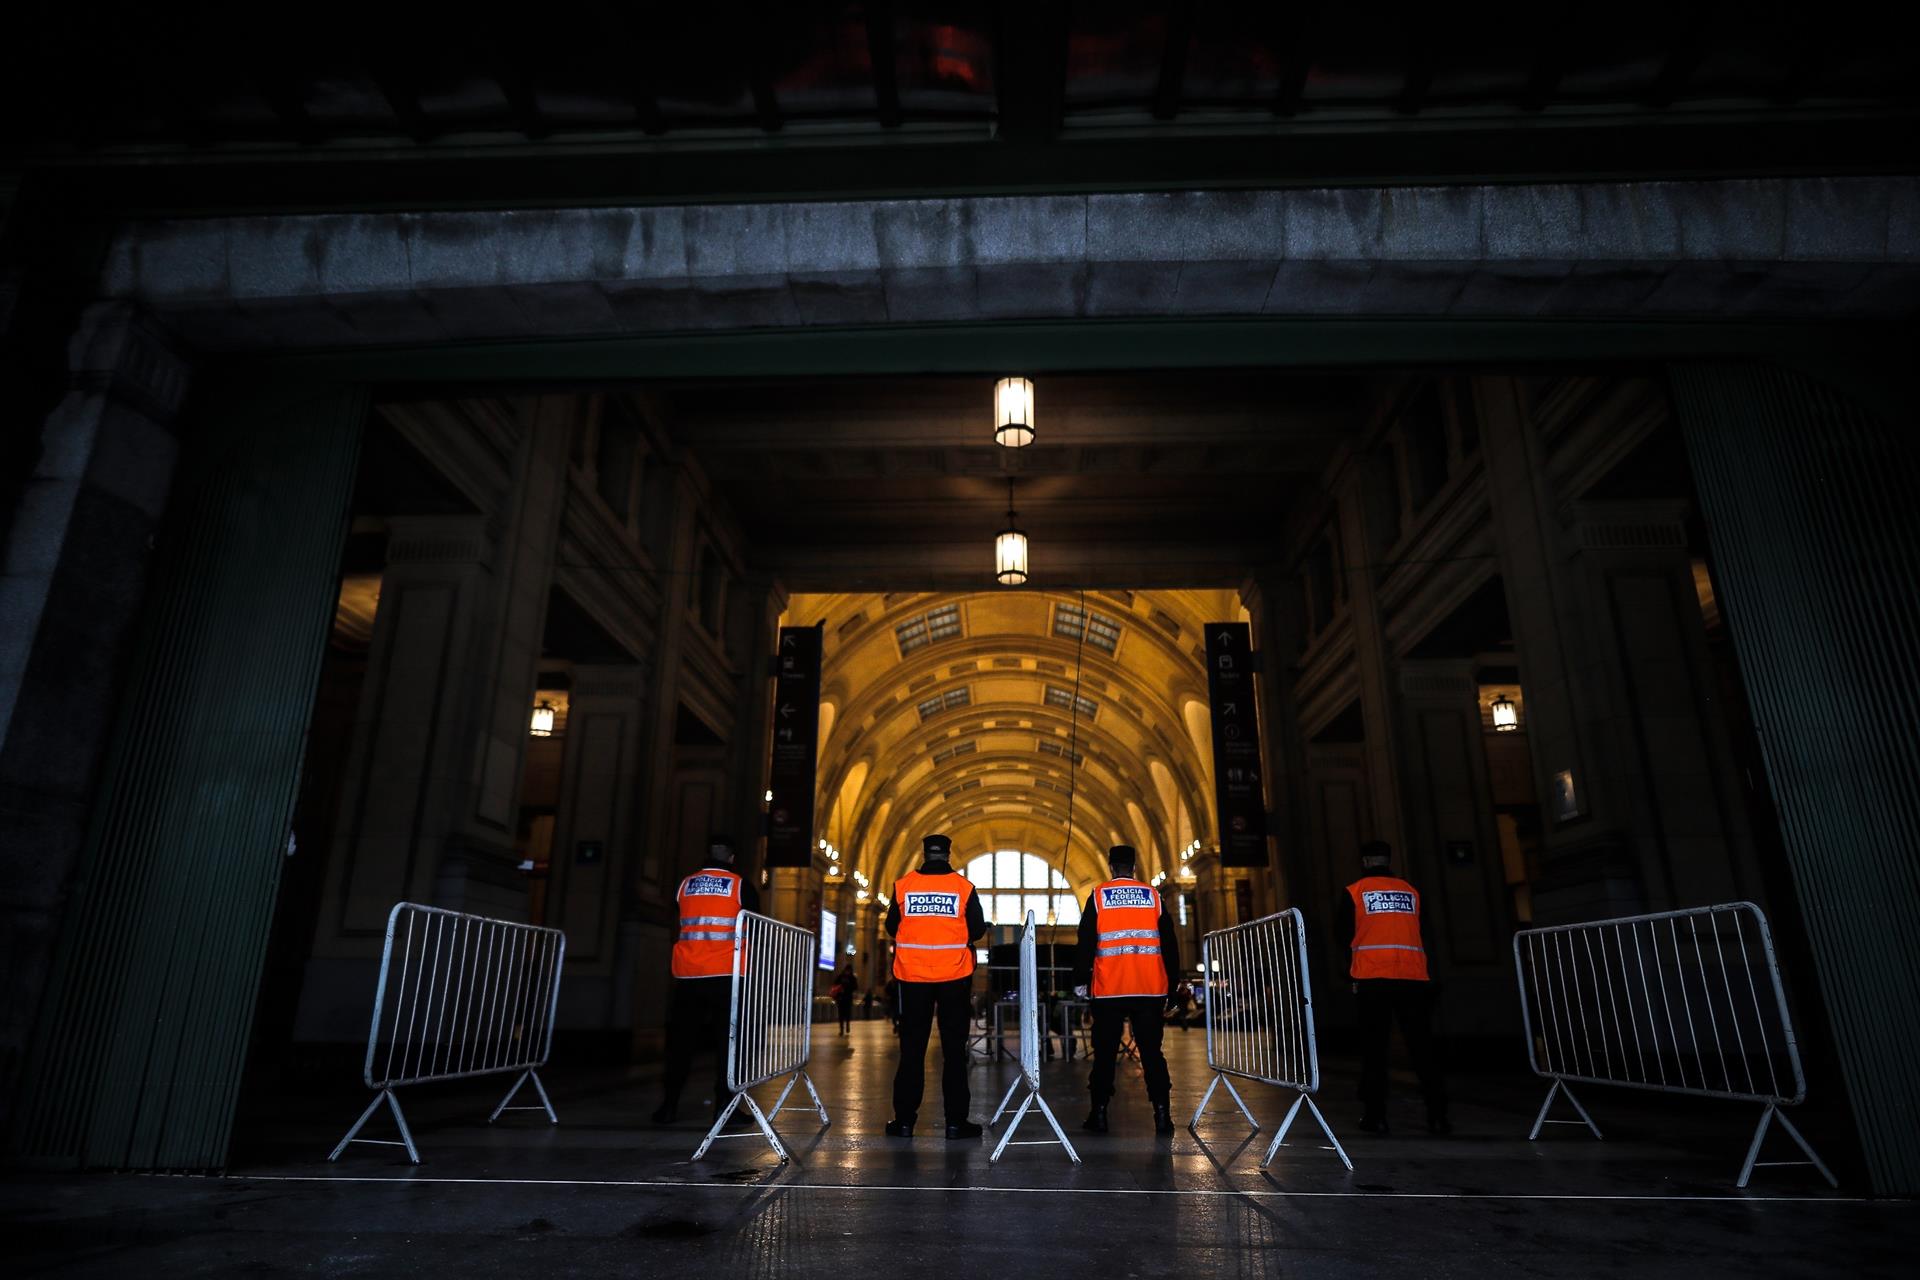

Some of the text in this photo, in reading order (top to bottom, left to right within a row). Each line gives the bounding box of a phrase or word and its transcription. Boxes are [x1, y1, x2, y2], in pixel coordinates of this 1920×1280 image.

[910, 896, 953, 905] POLICIA
[1368, 893, 1410, 903] POLICIA
[910, 904, 953, 914] FEDERAL
[1370, 901, 1411, 911] FEDERAL
